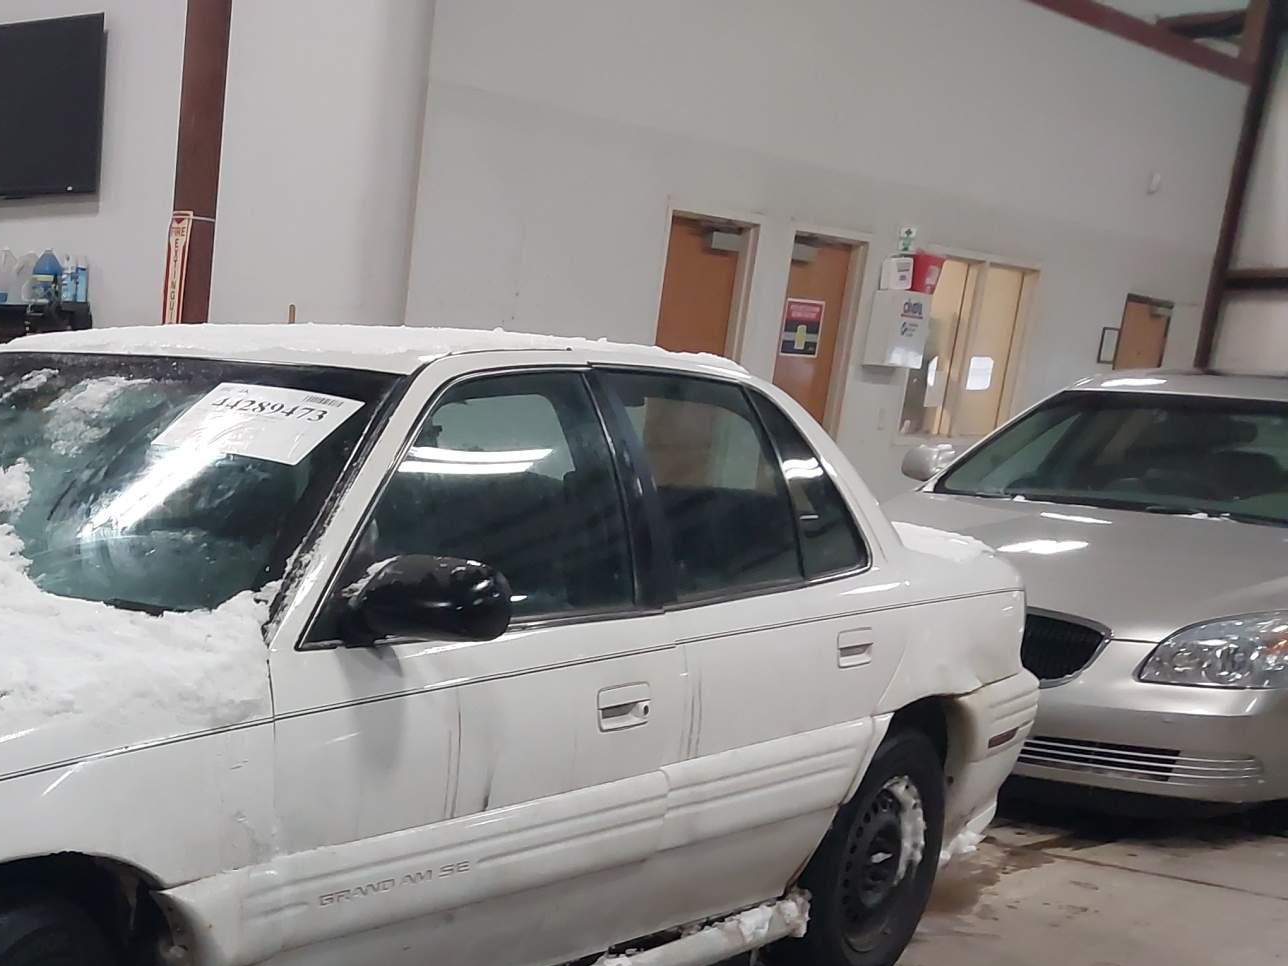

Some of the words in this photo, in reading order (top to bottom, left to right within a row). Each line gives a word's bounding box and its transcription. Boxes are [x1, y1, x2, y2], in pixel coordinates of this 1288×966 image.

[169, 239, 180, 323] EXTINGUI
[211, 397, 328, 422] 44289473
[319, 878, 395, 906] GRAND
[399, 869, 433, 887] AM
[439, 860, 470, 878] SE
